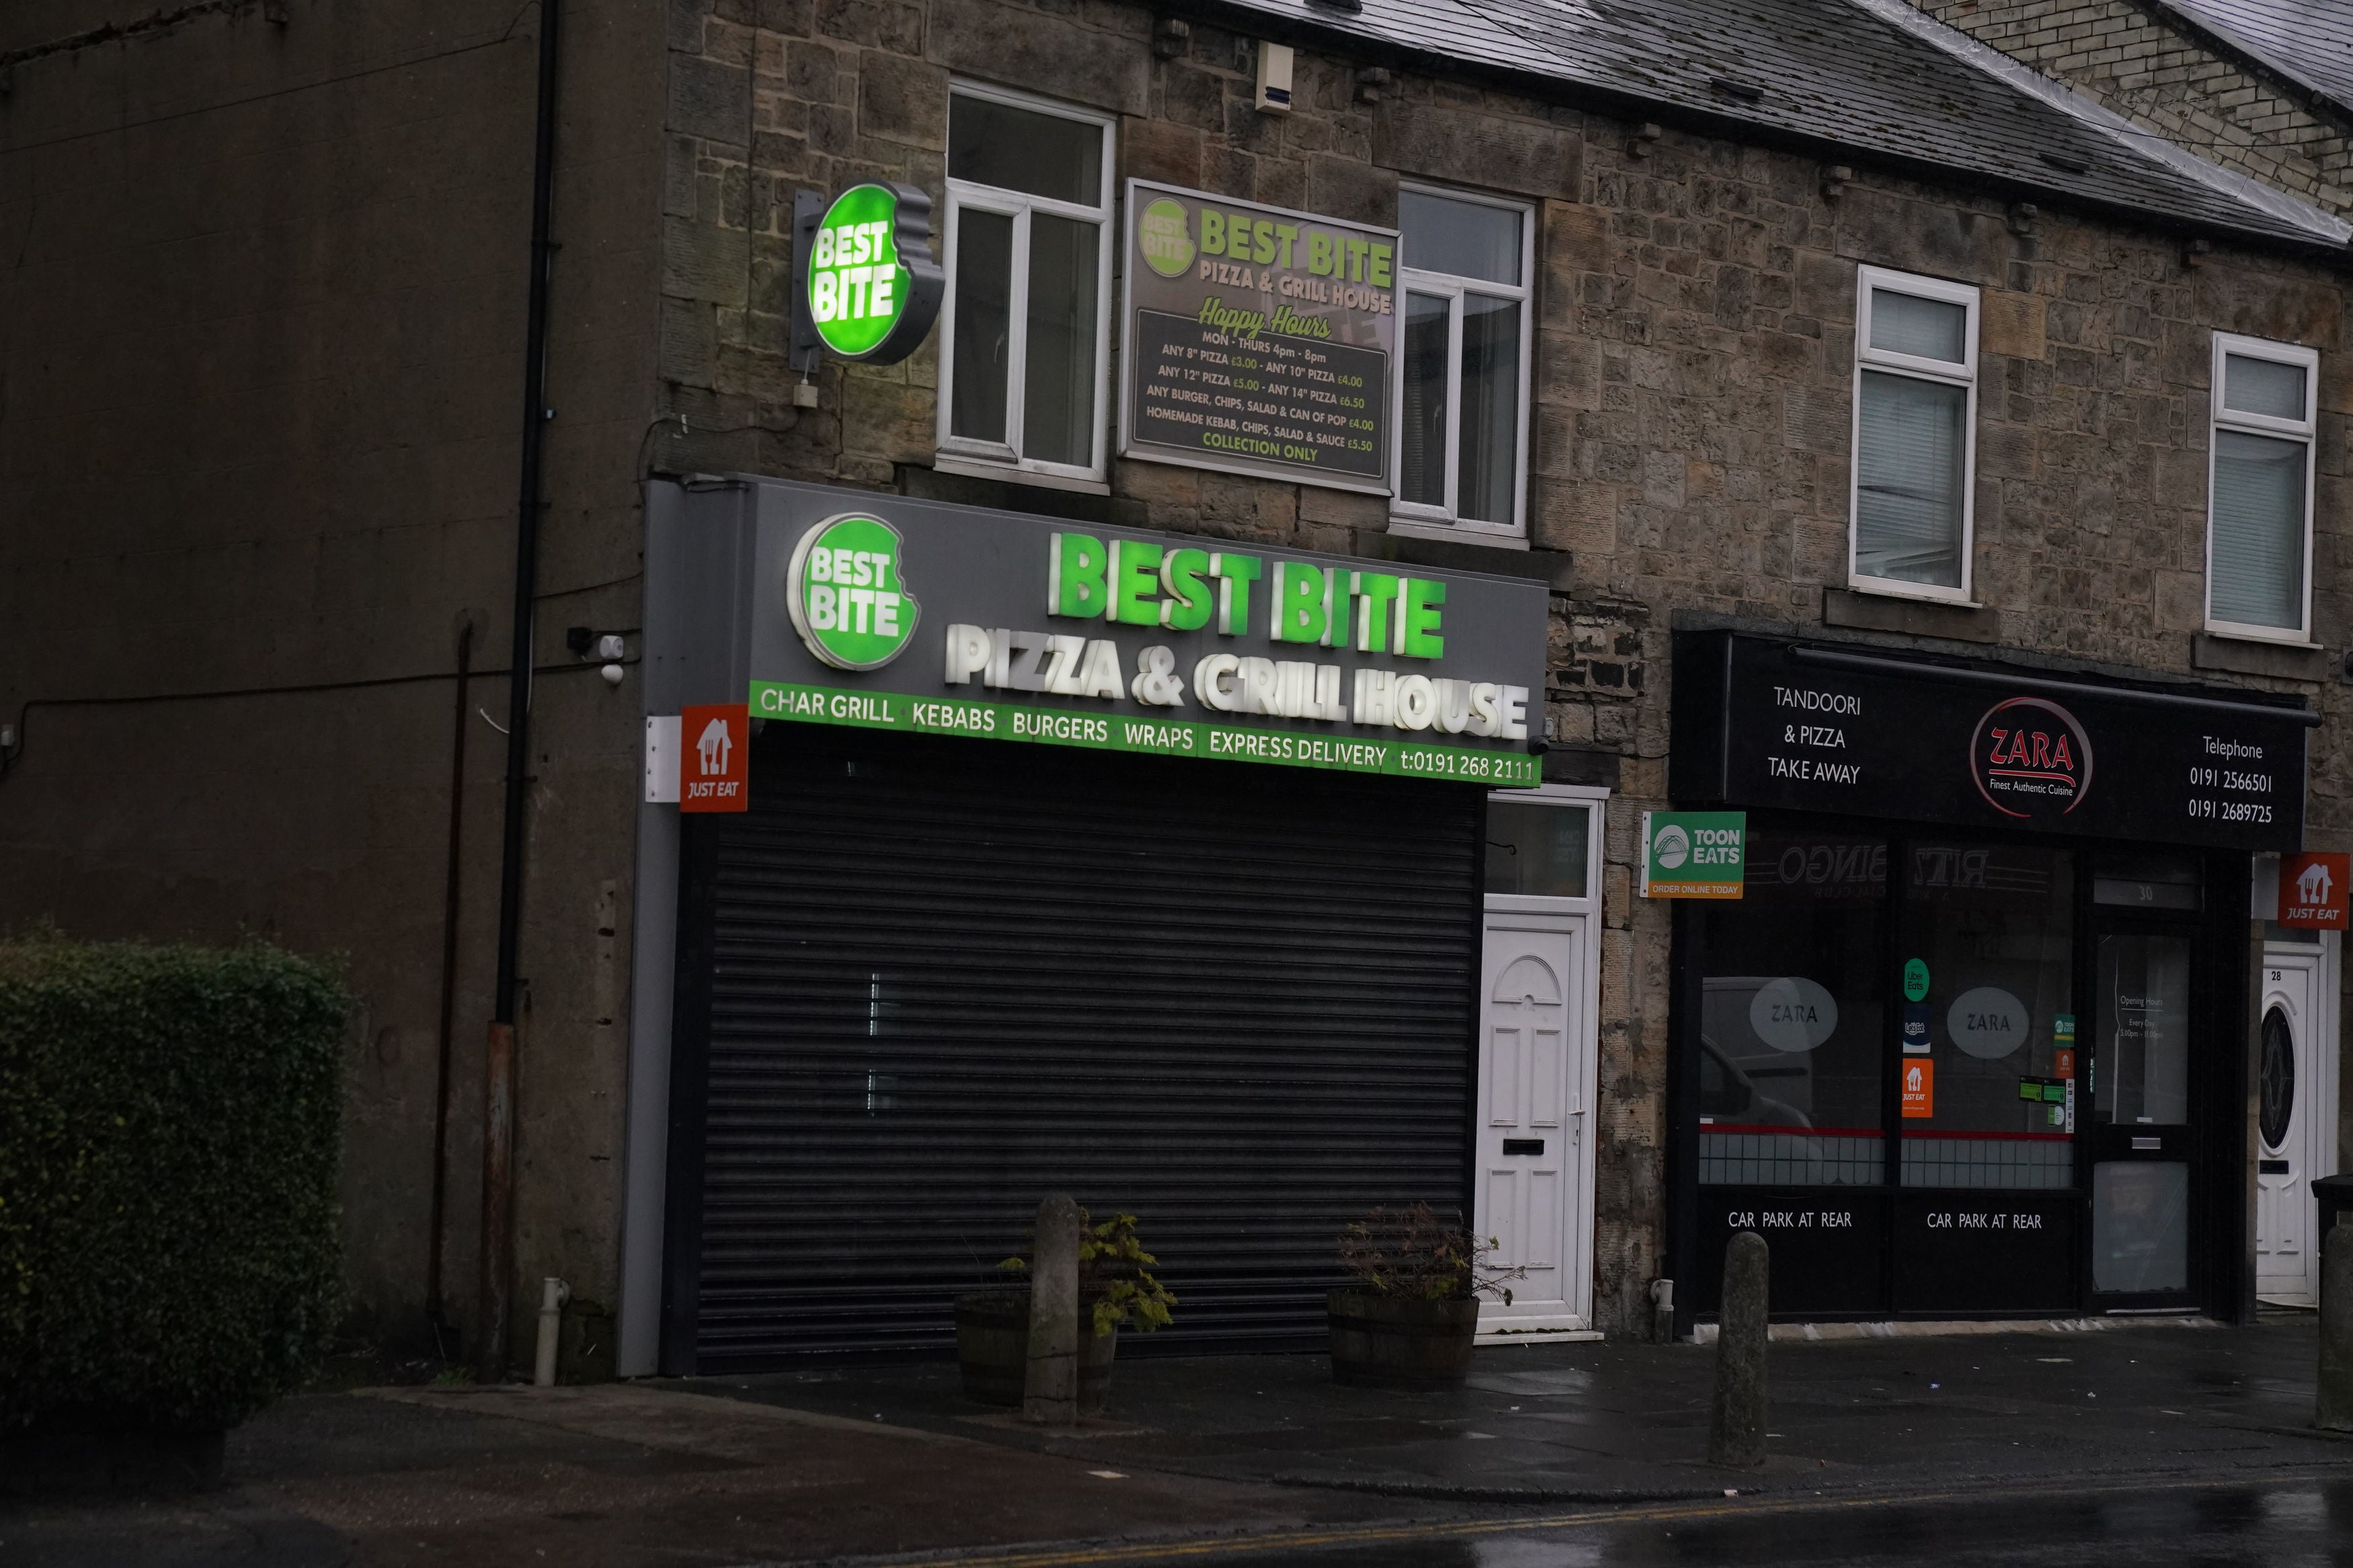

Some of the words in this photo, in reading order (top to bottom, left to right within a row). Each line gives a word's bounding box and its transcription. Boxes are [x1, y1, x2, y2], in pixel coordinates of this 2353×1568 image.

[1144, 213, 1182, 237] BEST
[815, 221, 887, 268] BEST
[1144, 235, 1186, 261] BITE
[1201, 208, 1298, 268] BEST
[1309, 230, 1392, 288] BITE
[813, 263, 896, 323] BITE
[1200, 260, 1254, 290] PIZZA
[1259, 273, 1273, 293] &
[1279, 276, 1327, 303] GRILL
[1332, 287, 1391, 315] HOUSE
[1197, 296, 1264, 340] Happy
[1271, 305, 1331, 337] Hours
[1202, 331, 1228, 346] MON
[1238, 337, 1270, 353] THURS
[1273, 345, 1295, 358] 4pm
[1304, 349, 1326, 364] 8pm
[1162, 345, 1183, 358] ANY
[1187, 347, 1197, 360] 8"
[1201, 350, 1229, 366] PIZZA
[1231, 356, 1257, 370] £3.00
[1266, 362, 1287, 375] ANY
[1291, 366, 1306, 377] 10"
[1308, 368, 1334, 383] PIZZA
[1338, 374, 1362, 388] £4.00
[1158, 365, 1179, 378] ANY
[1184, 369, 1200, 381] 12"
[1203, 372, 1231, 387] PIZZA
[1234, 377, 1259, 391] £5.00
[1268, 383, 1289, 397] ANY
[1292, 387, 1308, 399] 14"
[1310, 390, 1337, 405] PIZZA
[1340, 396, 1364, 409] £6.50
[1146, 385, 1168, 399] ANY
[1172, 388, 1211, 407] BURGER,
[1215, 395, 1244, 411] CHIPS,
[1248, 401, 1277, 415] SALAD
[1280, 405, 1287, 417] &
[1290, 407, 1310, 421] CAN
[1313, 411, 1325, 422] OF
[1328, 413, 1346, 426] POP
[1349, 419, 1373, 431] £4.00
[1146, 406, 1203, 425] HOMEMADE
[1206, 416, 1239, 431] KEBAB,
[1242, 421, 1271, 437] CHIPS,
[1274, 426, 1304, 441] SALAD
[1307, 431, 1313, 442] &
[1316, 433, 1345, 448] SAUCE
[1348, 438, 1372, 452] £5.50
[1203, 433, 1279, 456] COLLECTION
[1284, 441, 1318, 462] ONLY
[811, 546, 890, 589] BEST
[1047, 532, 1261, 636] BEST
[1271, 561, 1446, 659] BITE
[809, 585, 900, 637] BITE
[945, 623, 1125, 700] PIZZA
[1131, 645, 1185, 707] &
[1194, 653, 1347, 723] GRILL
[1353, 668, 1529, 740] HOUSE
[1773, 686, 1860, 715] TANDOORI
[760, 690, 825, 715] CHAR
[830, 694, 894, 723] GRILL
[912, 703, 995, 732] KEBABS
[1013, 712, 1107, 742] BURGERS
[1125, 723, 1193, 749] WRAPS
[1211, 731, 1292, 759] EXPRESS
[1298, 740, 1387, 768] DELIVERY
[1401, 751, 1455, 774] t:0191
[1460, 755, 1488, 776] 268
[1494, 759, 1533, 780] 2111
[1785, 727, 1796, 743] &
[1800, 726, 1846, 749] PIZZA
[2203, 735, 2262, 760] Telephone
[1989, 727, 2074, 771] ZARA
[1768, 757, 1810, 780] TAKE
[1814, 761, 1860, 784] AWAY
[2190, 767, 2218, 786] 0191
[2223, 774, 2272, 793] 2566501
[688, 782, 715, 800] JUST
[717, 781, 739, 797] EAT
[1990, 779, 2010, 790] Finest
[2013, 782, 2046, 794] Authentic
[2048, 784, 2073, 796] Cuisine
[2189, 798, 2217, 818] 0191
[2222, 802, 2272, 823] 2689725
[1694, 829, 1740, 843] TOON
[1693, 847, 1740, 864] EATS
[1653, 885, 1679, 893] ORDER
[1682, 885, 1709, 894] ONLINE
[1711, 886, 1738, 895] TODAY
[2139, 886, 2153, 900] 30
[2288, 908, 2313, 920] JUST
[2317, 908, 2340, 920] EAT
[1907, 981, 1923, 990] Eats
[1908, 972, 1923, 980] Uber
[2272, 971, 2281, 981] 28
[1771, 1004, 1818, 1024] ZARA
[2120, 995, 2145, 1007] Opening
[2146, 997, 2163, 1006] Hours
[1967, 1013, 2011, 1032] ZARA
[2129, 1019, 2143, 1028] Every
[1728, 1212, 1755, 1227] CAR
[1762, 1212, 1794, 1228] PARK
[1798, 1212, 1814, 1228] AT
[1821, 1212, 1852, 1227] REAR
[1927, 1213, 1952, 1229] CAR
[1958, 1214, 1988, 1229] PARK
[1991, 1214, 2006, 1229] AT
[2012, 1214, 2042, 1229] REAR
